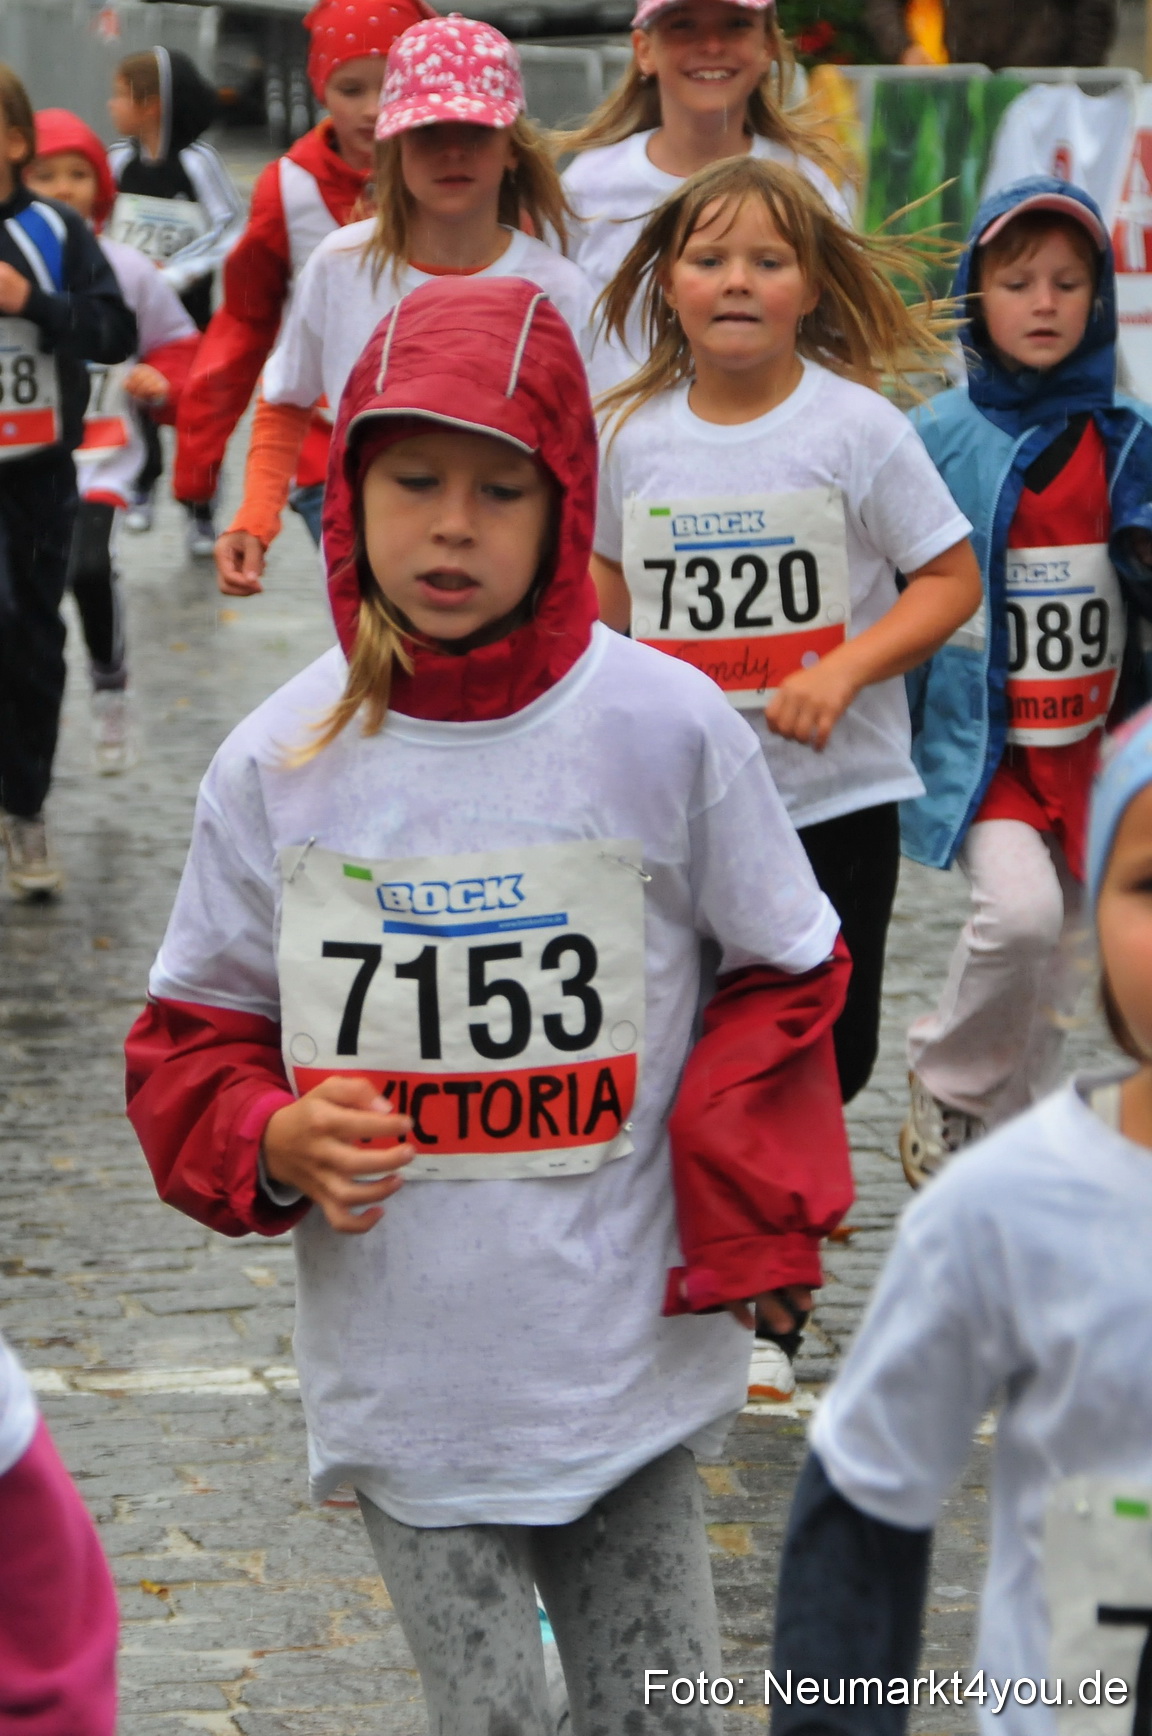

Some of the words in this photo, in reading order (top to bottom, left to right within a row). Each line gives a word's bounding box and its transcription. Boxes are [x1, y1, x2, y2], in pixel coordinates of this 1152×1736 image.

[0, 354, 38, 404] 8
[672, 510, 766, 537] BOCK
[643, 549, 820, 632] 7320
[674, 642, 776, 694] ndy
[375, 873, 526, 915] BOCK
[321, 933, 603, 1060] 7153
